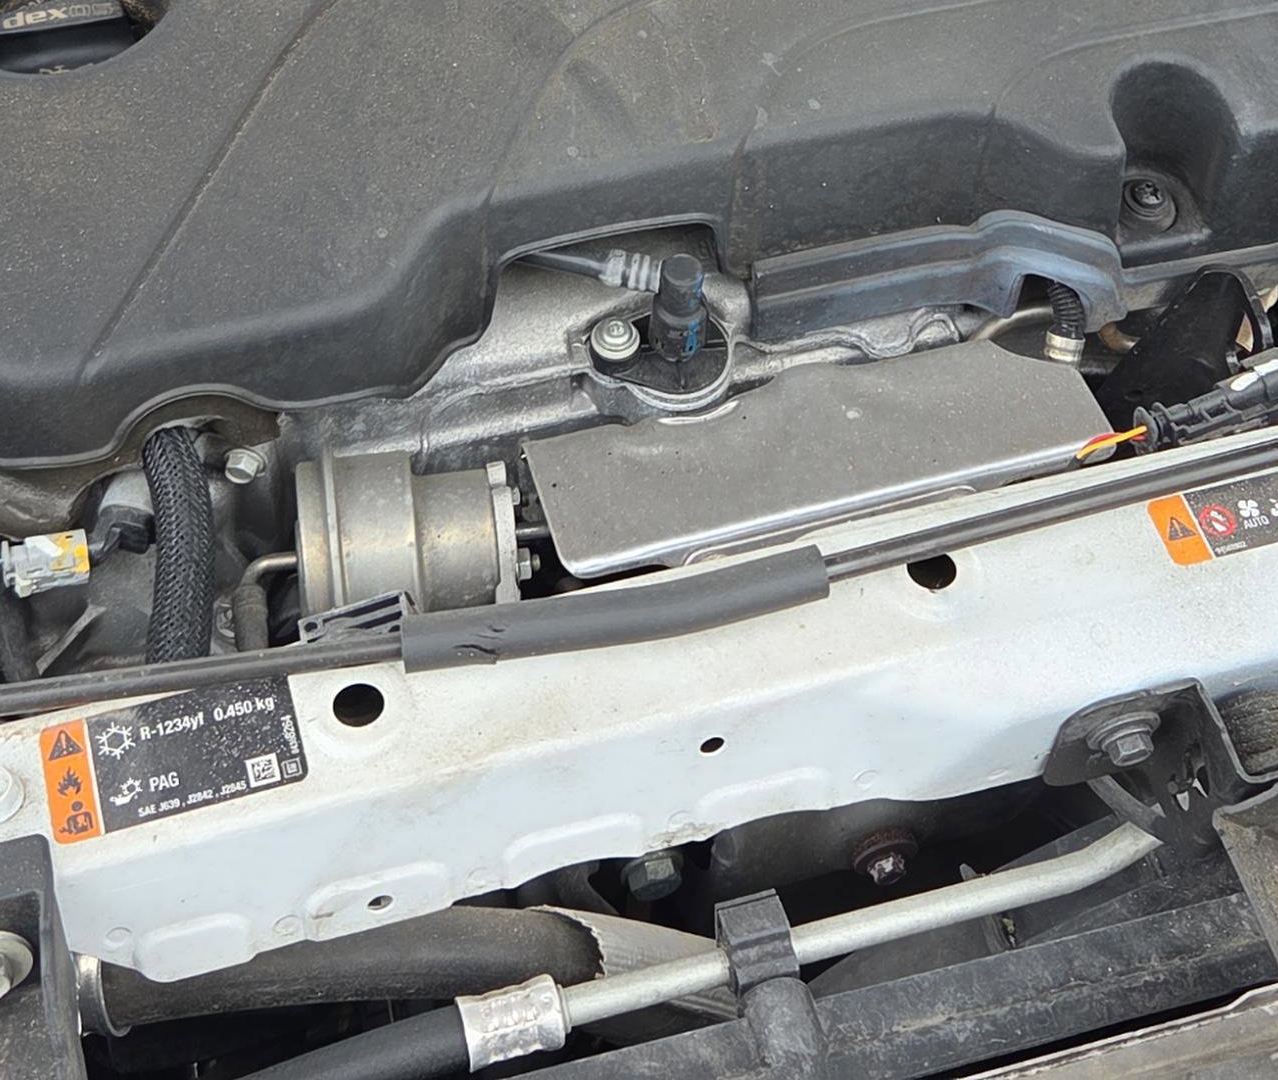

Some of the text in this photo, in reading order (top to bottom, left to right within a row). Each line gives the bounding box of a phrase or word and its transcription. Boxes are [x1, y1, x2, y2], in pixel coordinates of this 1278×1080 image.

[1243, 515, 1270, 530] AUTO
[139, 695, 275, 741] R-1234yf 0.450 kg
[148, 771, 180, 792] PAG
[137, 803, 157, 818] SAE
